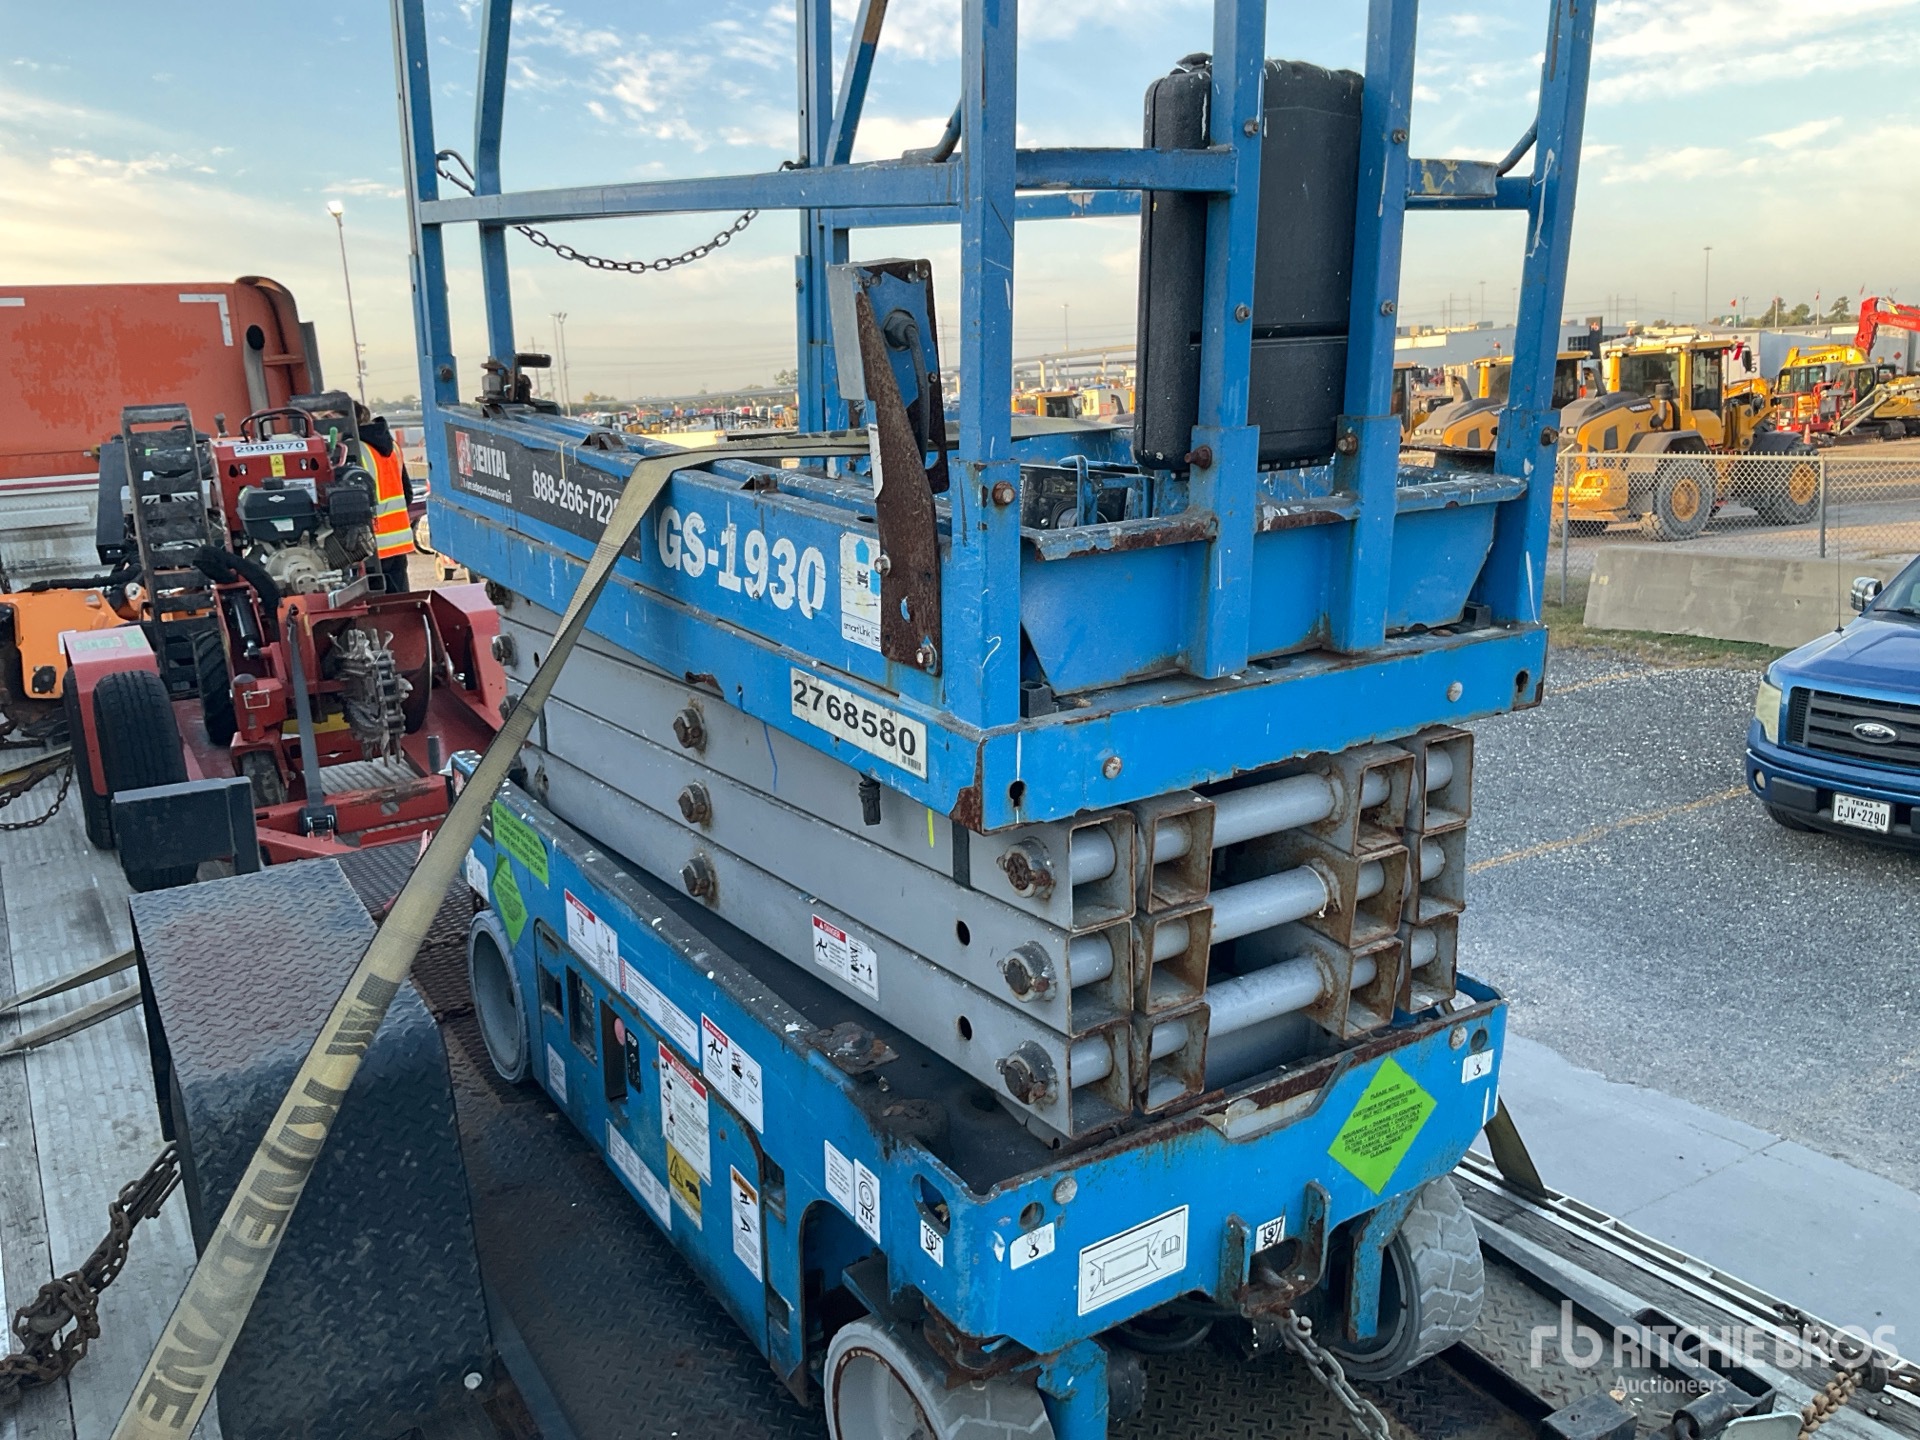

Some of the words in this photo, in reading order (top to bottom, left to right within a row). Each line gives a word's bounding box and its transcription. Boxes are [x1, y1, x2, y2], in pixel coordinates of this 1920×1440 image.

[236, 442, 304, 453] 2998870
[532, 470, 620, 524] 888-266-722
[659, 506, 826, 619] GS-1930
[793, 679, 916, 756] 2768580
[1852, 799, 1873, 808] TEXAS
